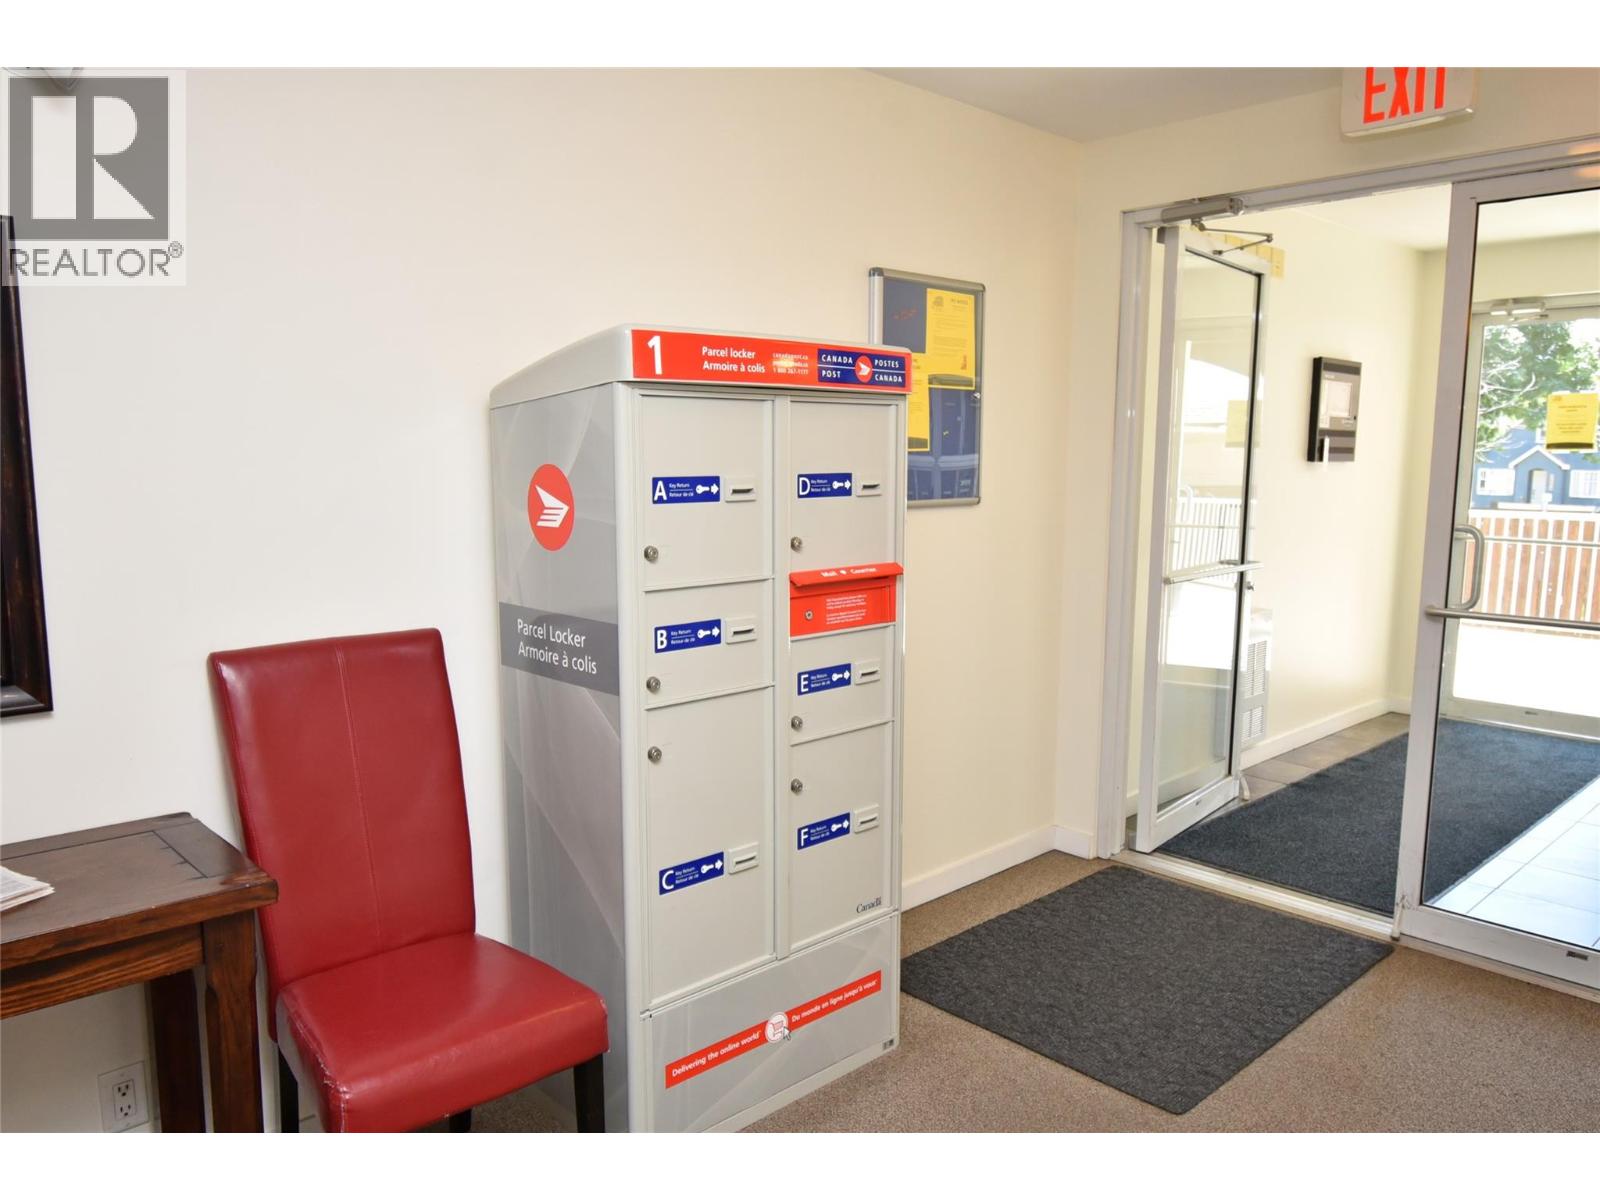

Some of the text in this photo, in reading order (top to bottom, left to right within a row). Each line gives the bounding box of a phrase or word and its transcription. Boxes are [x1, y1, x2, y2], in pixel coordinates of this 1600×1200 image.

[647, 335, 663, 375] 1
[701, 346, 756, 359] Parcel locker
[821, 354, 853, 364] CANADA
[702, 361, 738, 372] Armoire
[740, 360, 746, 372] à
[747, 363, 766, 374] colis
[874, 359, 900, 369] POSTES
[821, 370, 841, 379] POST
[874, 374, 903, 383] CANADA
[654, 480, 668, 501] A
[799, 477, 811, 495] D
[517, 618, 587, 648] Parcel Locker
[656, 629, 668, 650] B
[518, 641, 598, 675] Armoire à colis
[801, 674, 809, 693] E
[801, 828, 809, 847] F
[662, 870, 674, 890] C
[856, 897, 882, 914] Canada
[791, 1013, 801, 1023] Du
[671, 1055, 707, 1078] Delivering
[707, 1050, 719, 1061] the
[719, 1041, 740, 1056] online
